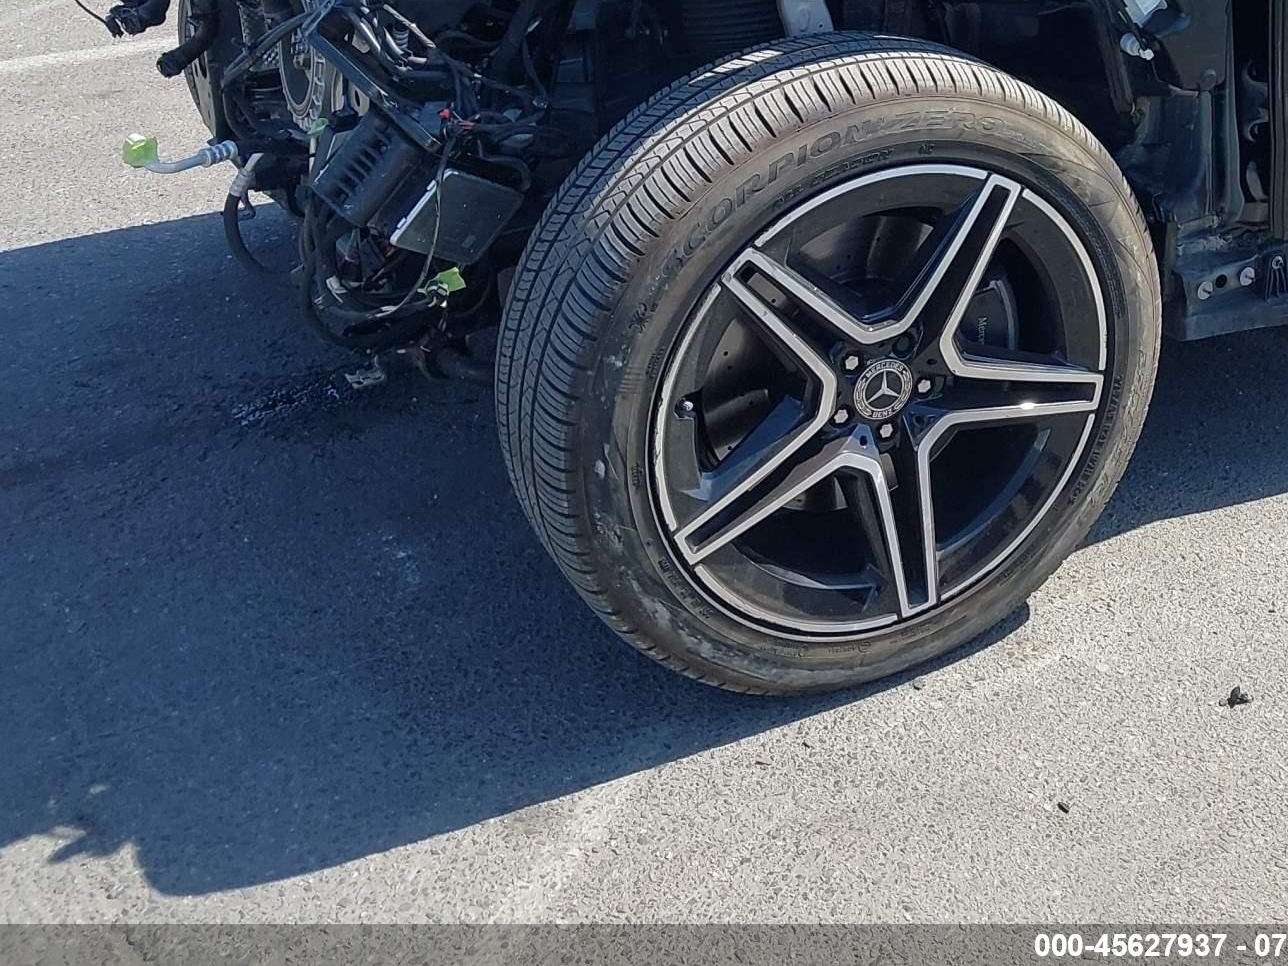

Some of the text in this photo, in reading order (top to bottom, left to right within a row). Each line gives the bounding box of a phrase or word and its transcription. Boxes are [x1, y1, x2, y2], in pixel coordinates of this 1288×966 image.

[661, 118, 880, 278] SCORPION
[865, 361, 904, 378] MERCEDES
[871, 408, 893, 418] BENZ
